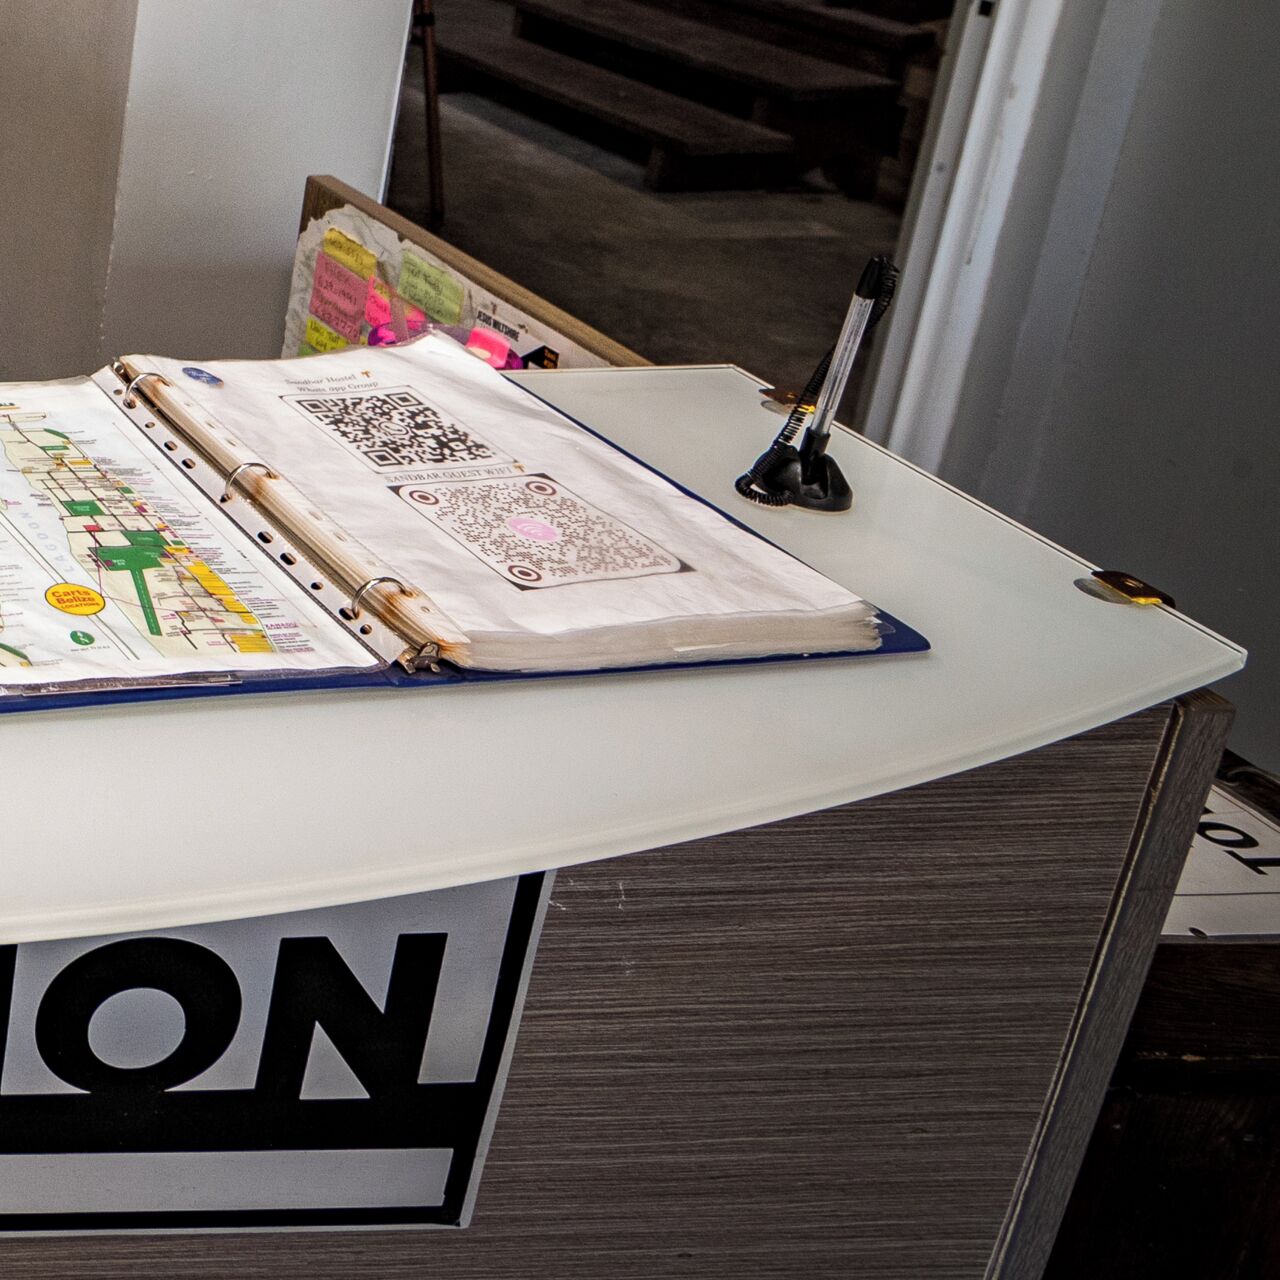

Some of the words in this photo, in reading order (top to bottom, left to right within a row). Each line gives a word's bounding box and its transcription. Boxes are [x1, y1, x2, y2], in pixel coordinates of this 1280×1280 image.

[384, 472, 441, 484] SANDBAR
[442, 469, 481, 479] GUEST
[483, 466, 513, 476] WIFI
[52, 590, 90, 598] Carts
[56, 596, 95, 604] Belize
